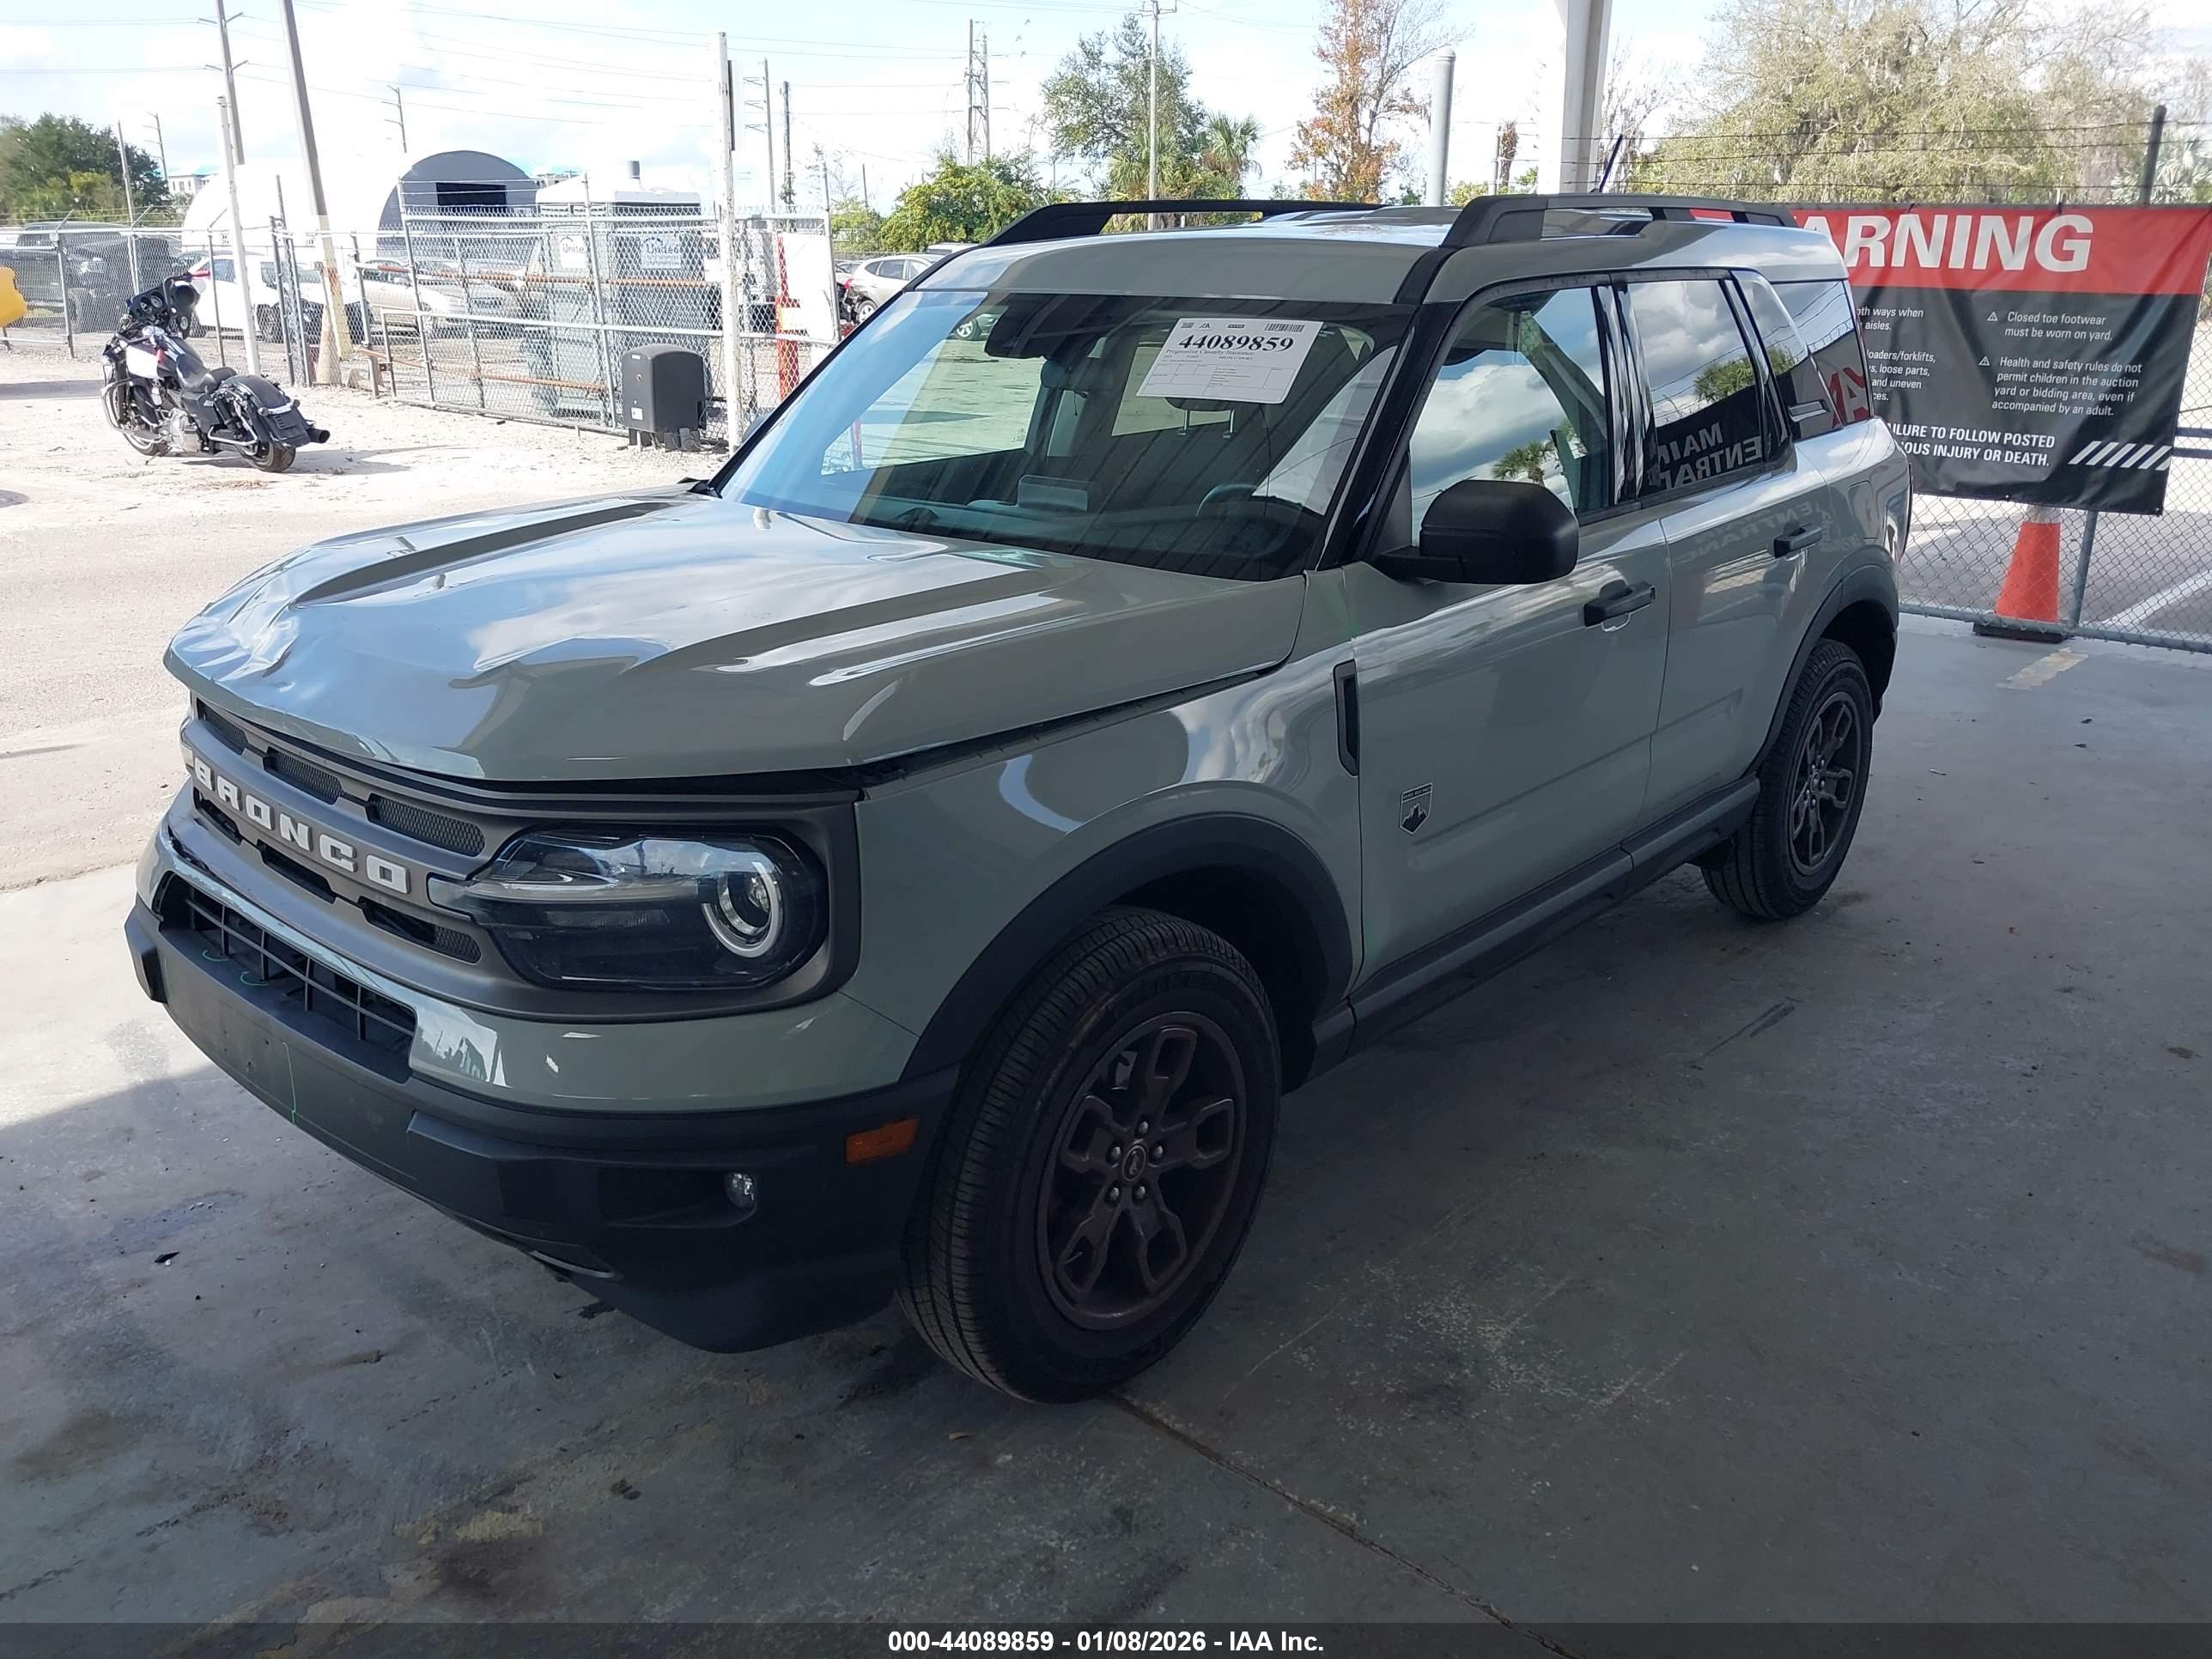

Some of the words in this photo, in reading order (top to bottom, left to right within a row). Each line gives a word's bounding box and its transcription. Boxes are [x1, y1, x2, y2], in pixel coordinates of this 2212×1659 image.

[1872, 307, 1897, 319] ways
[1899, 307, 1924, 318] when
[2007, 311, 2040, 324] Closed
[2042, 313, 2058, 324] toe
[2060, 313, 2106, 325] footwear
[1864, 320, 1892, 331] aisles.
[1179, 334, 1294, 352] 44089859
[2004, 326, 2029, 337] must
[2032, 327, 2044, 337] be
[2045, 330, 2071, 339] worn
[2074, 331, 2087, 340] on
[2088, 330, 2113, 343] yard.
[1879, 362, 1904, 374] loose
[1905, 366, 1930, 377] parts,
[2000, 356, 2031, 368] Health
[2032, 358, 2051, 368] and
[2052, 359, 2083, 373] safety
[2084, 361, 2109, 372] rules
[2111, 362, 2123, 373] do
[2124, 363, 2142, 374] not
[1872, 377, 1888, 387] and
[1889, 380, 1922, 389] uneven
[1996, 371, 2028, 383] permit
[2029, 372, 2068, 385] children
[2069, 374, 2080, 385] in
[2081, 375, 2098, 386] the
[2100, 377, 2139, 388] auction
[1994, 386, 2016, 398] yard
[2019, 386, 2030, 396] or
[2033, 386, 2069, 401] bidding
[2071, 391, 2095, 402] area,
[2098, 392, 2124, 402] even
[2126, 391, 2136, 403] if
[1991, 400, 2056, 413] accompanied
[2058, 404, 2070, 415] by
[2072, 404, 2084, 414] an
[2086, 404, 2114, 416] adult.
[1930, 426, 1947, 440] TO
[1948, 428, 2002, 444] FOLLOW
[2003, 432, 2056, 448] POSTED
[1901, 441, 1931, 455] OUS
[1933, 444, 1982, 459] INJURY
[1983, 448, 2002, 461] OR
[2003, 450, 2050, 467] DEATH.
[194, 757, 411, 895] BRONCO
